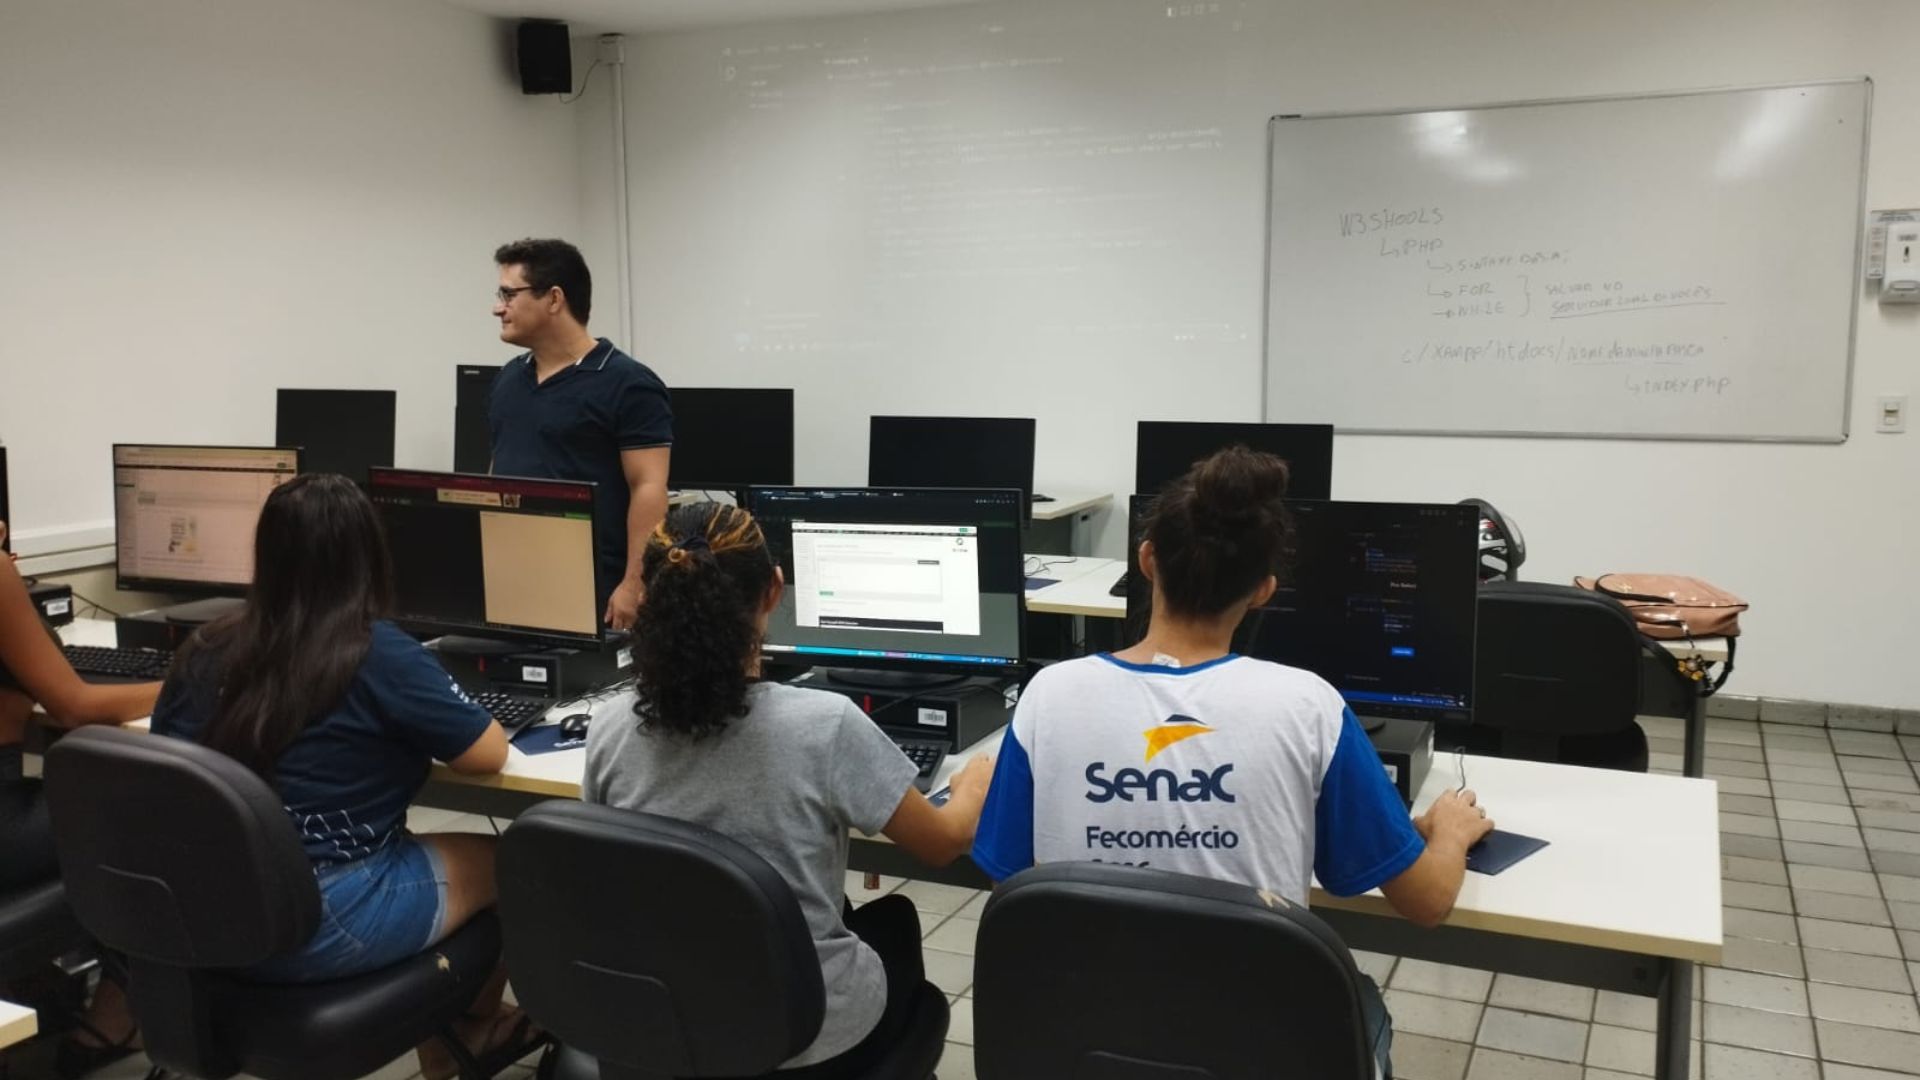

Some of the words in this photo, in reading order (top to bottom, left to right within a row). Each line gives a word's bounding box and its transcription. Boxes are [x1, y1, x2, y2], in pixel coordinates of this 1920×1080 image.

[1403, 238, 1443, 255] PHP
[1458, 281, 1495, 297] FOR
[1085, 762, 1236, 803] Senac
[1086, 824, 1239, 849] Fecomércio
